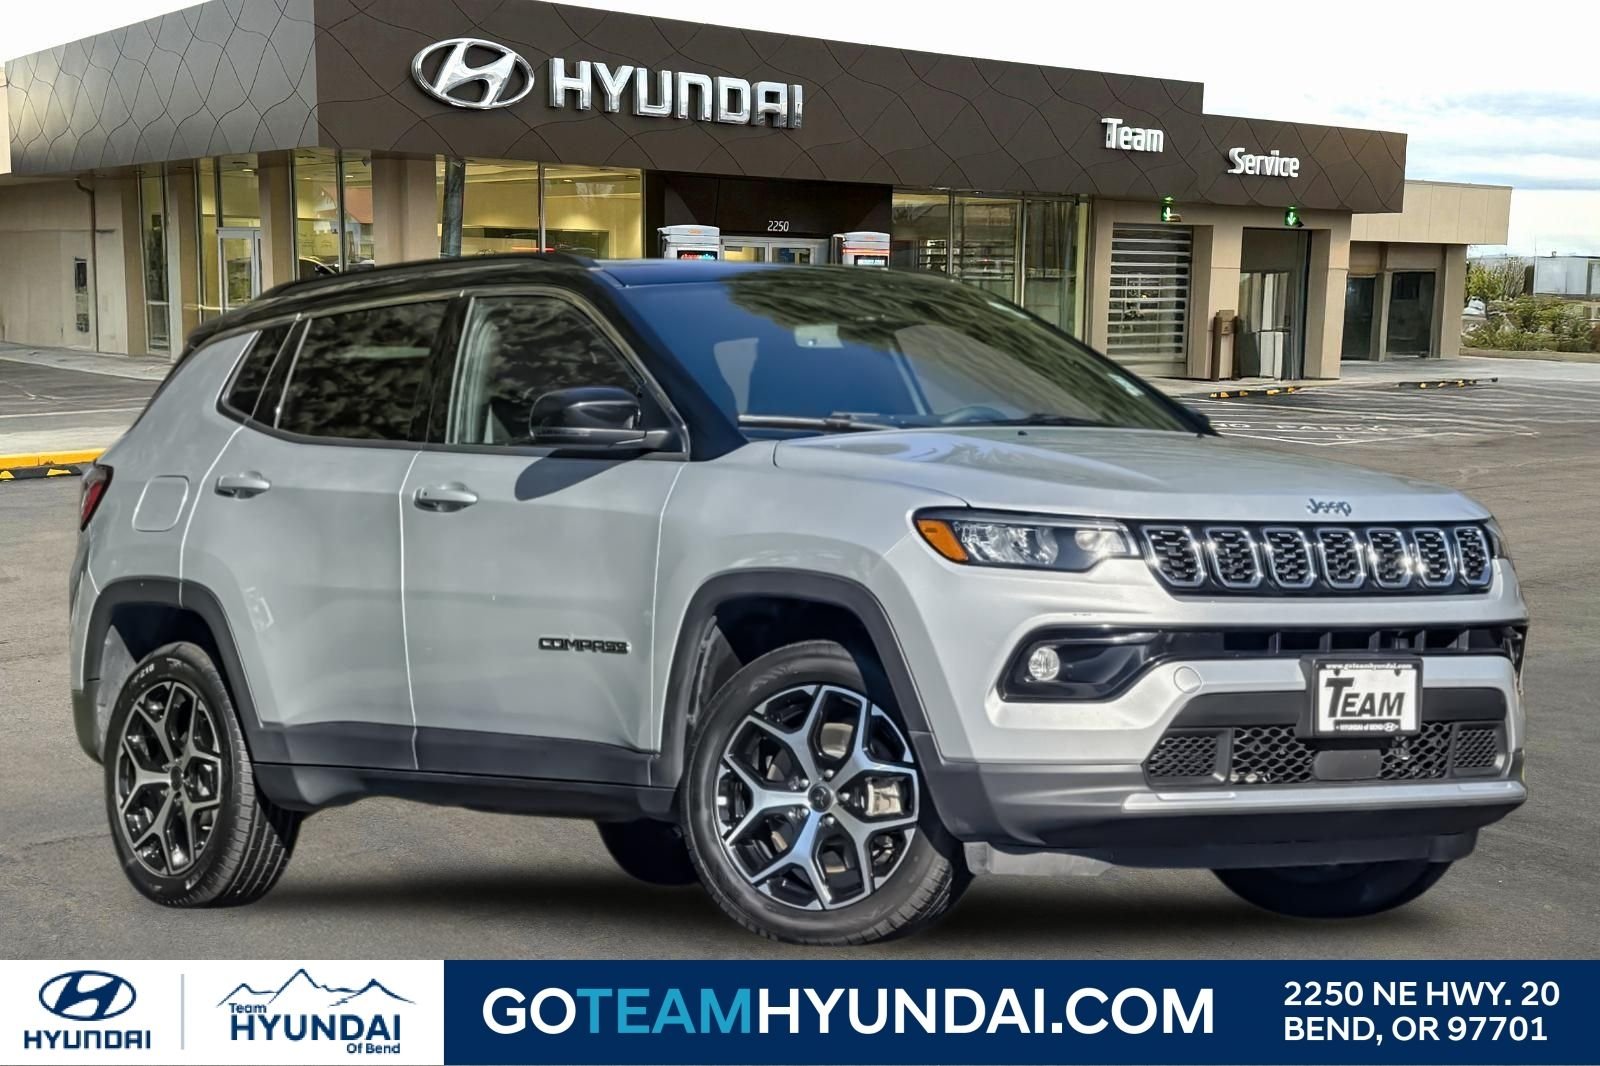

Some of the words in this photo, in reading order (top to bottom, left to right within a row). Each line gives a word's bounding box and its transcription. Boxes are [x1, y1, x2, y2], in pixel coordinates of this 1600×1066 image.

[549, 57, 803, 129] HYUNDAI
[1101, 117, 1164, 153] Team
[1227, 147, 1300, 178] Service
[767, 220, 790, 233] 2250
[1306, 498, 1352, 516] Jeep
[538, 637, 629, 654] COMPASS
